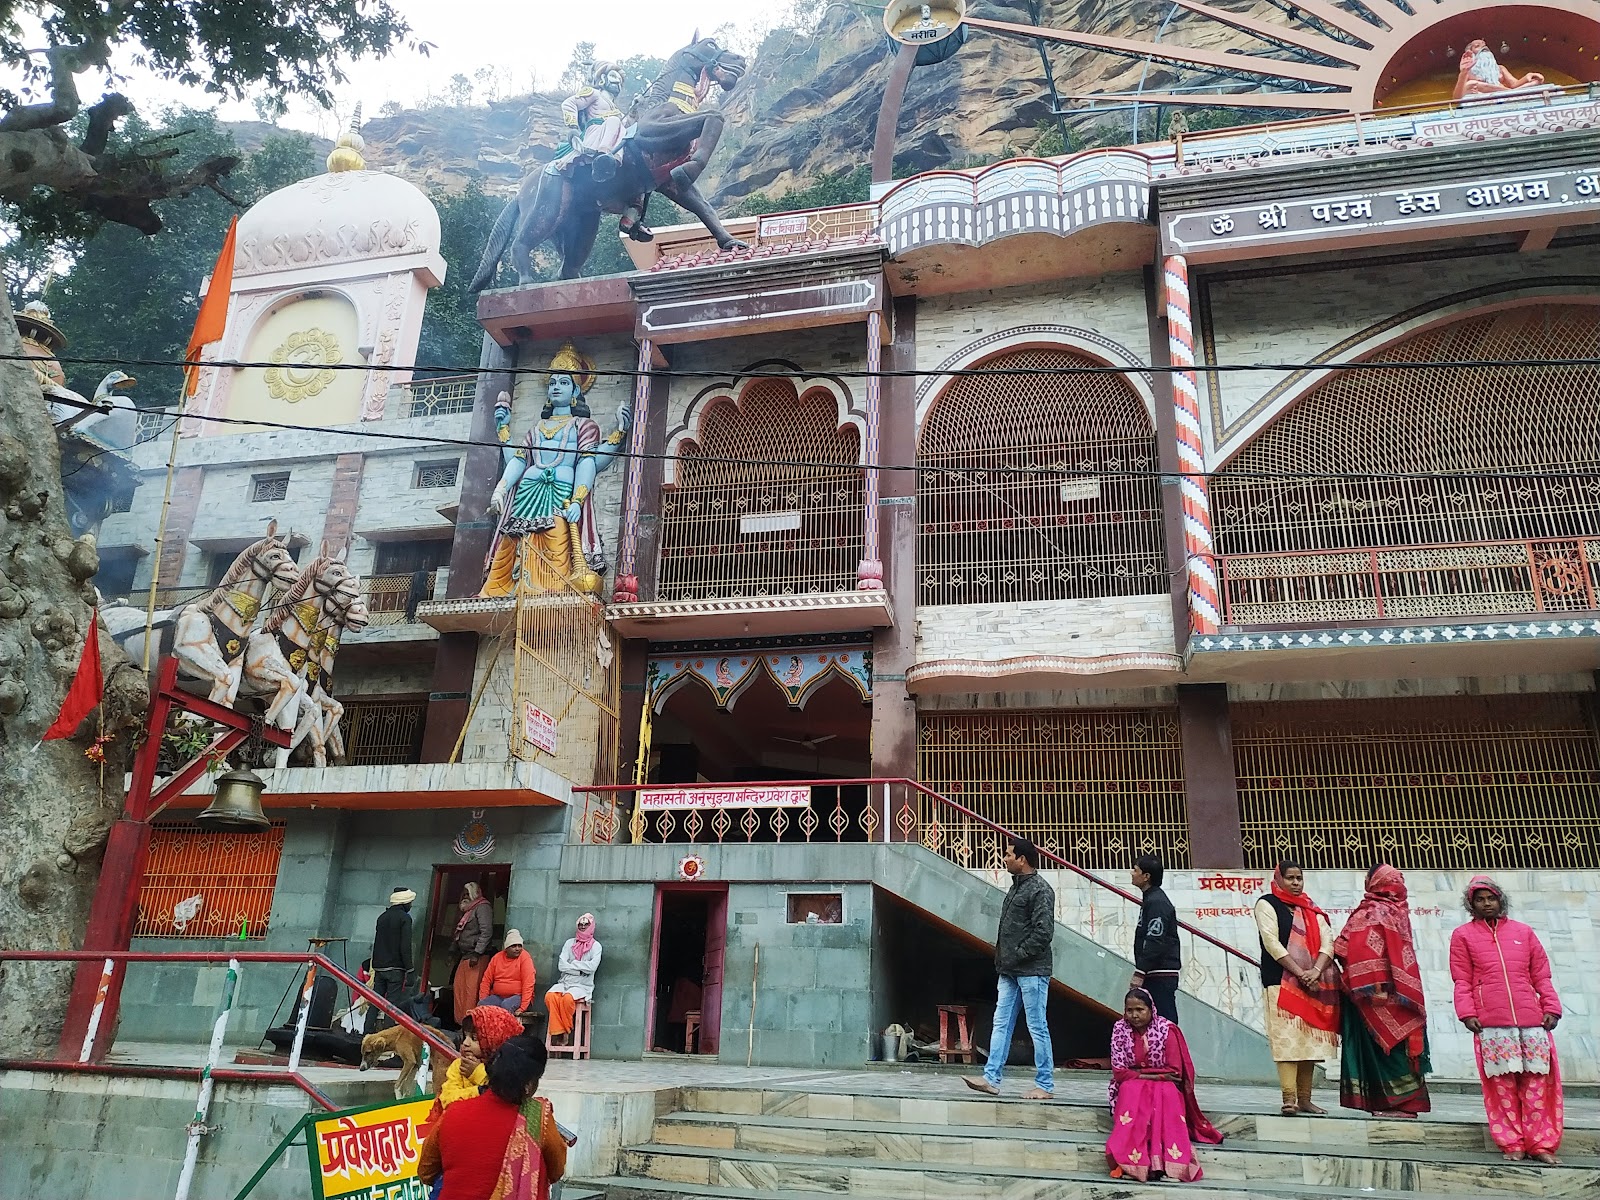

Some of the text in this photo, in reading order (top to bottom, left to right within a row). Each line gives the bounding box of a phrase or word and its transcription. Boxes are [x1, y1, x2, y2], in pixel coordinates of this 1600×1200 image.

[911, 30, 937, 39] मरीचि
[1423, 122, 1460, 137] तारा
[1258, 203, 1288, 228] श्री
[1311, 200, 1372, 222] परम
[1396, 192, 1440, 214] हंस
[764, 225, 778, 235] वीर
[779, 222, 806, 234] शिवाजी
[643, 790, 686, 807] महासती
[736, 789, 766, 803] मन्दिर
[767, 788, 789, 803] प्रवेश
[791, 789, 809, 805] द्वार
